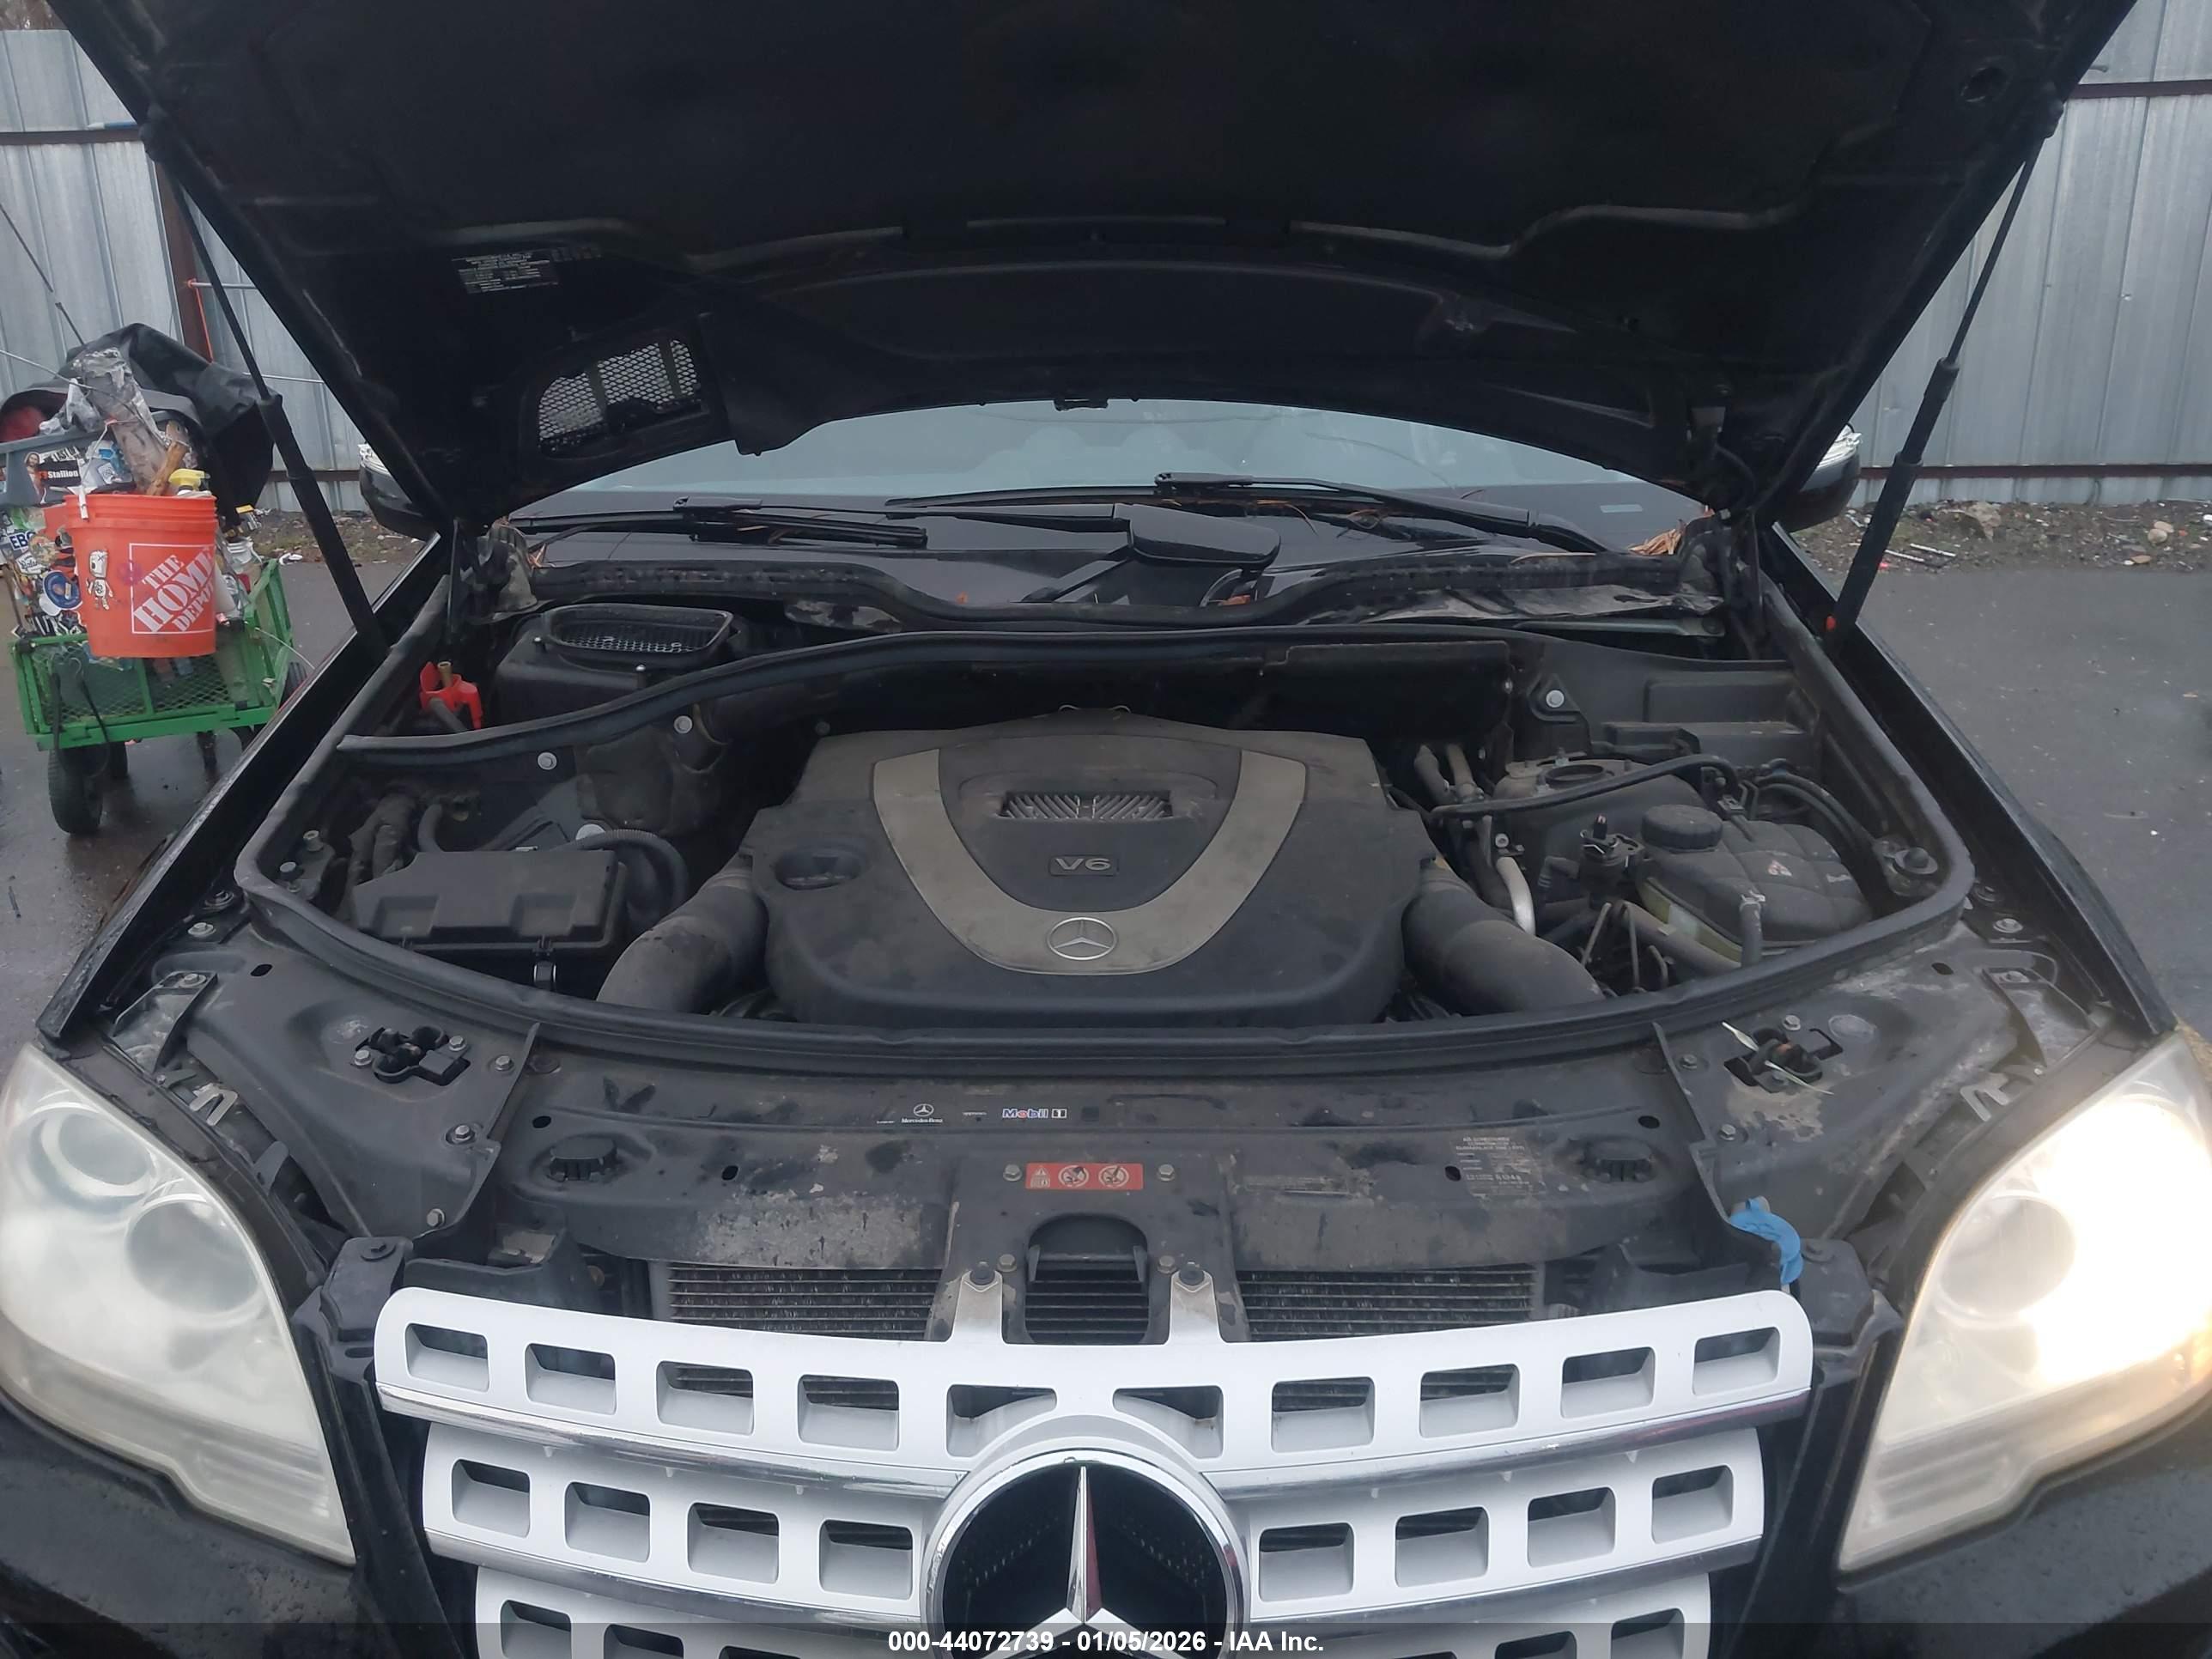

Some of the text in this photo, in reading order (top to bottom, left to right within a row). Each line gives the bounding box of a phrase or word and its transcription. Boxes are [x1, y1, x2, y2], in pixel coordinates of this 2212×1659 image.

[48, 470, 78, 478] Stallion
[142, 555, 185, 589] THE
[1055, 857, 1111, 871] V6
[1002, 1108, 1048, 1118] Mobil
